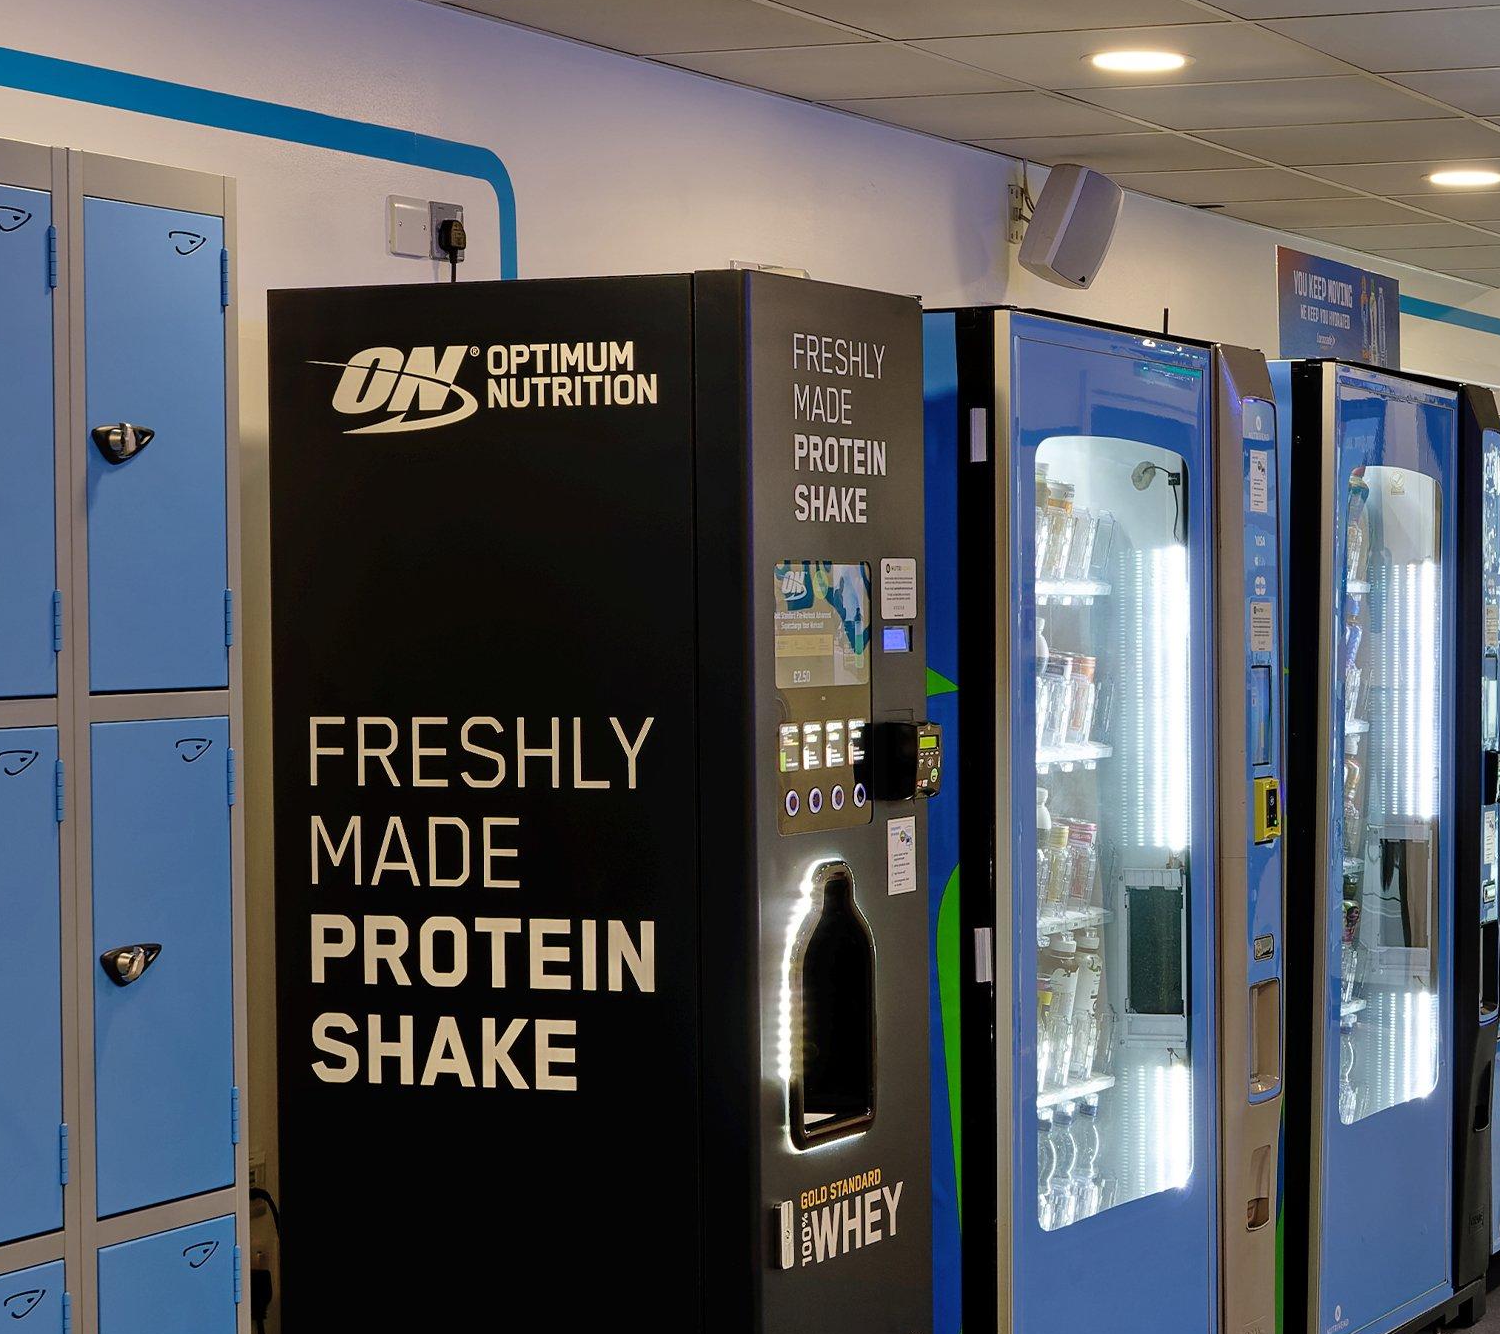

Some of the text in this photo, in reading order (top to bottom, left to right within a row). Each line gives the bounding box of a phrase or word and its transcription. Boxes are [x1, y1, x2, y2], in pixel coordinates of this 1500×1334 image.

[1293, 270, 1353, 308] YOU KEEP MOVING
[1307, 305, 1319, 323] KEEP
[487, 340, 635, 375] OPTIMUM
[792, 332, 887, 379] FRESHLY
[487, 373, 659, 409] NUTRITION
[792, 385, 853, 426] MADE
[792, 434, 887, 477] PROTEIN
[792, 485, 868, 524] SHAKE
[308, 715, 655, 790] FRESHLY
[309, 815, 521, 890] MADE
[309, 913, 657, 993] PROTEIN
[310, 1012, 579, 1092] SHAKE
[800, 1167, 882, 1211] GOLD STANDARD
[801, 1212, 814, 1267] 100%
[811, 1180, 904, 1264] WHEY
